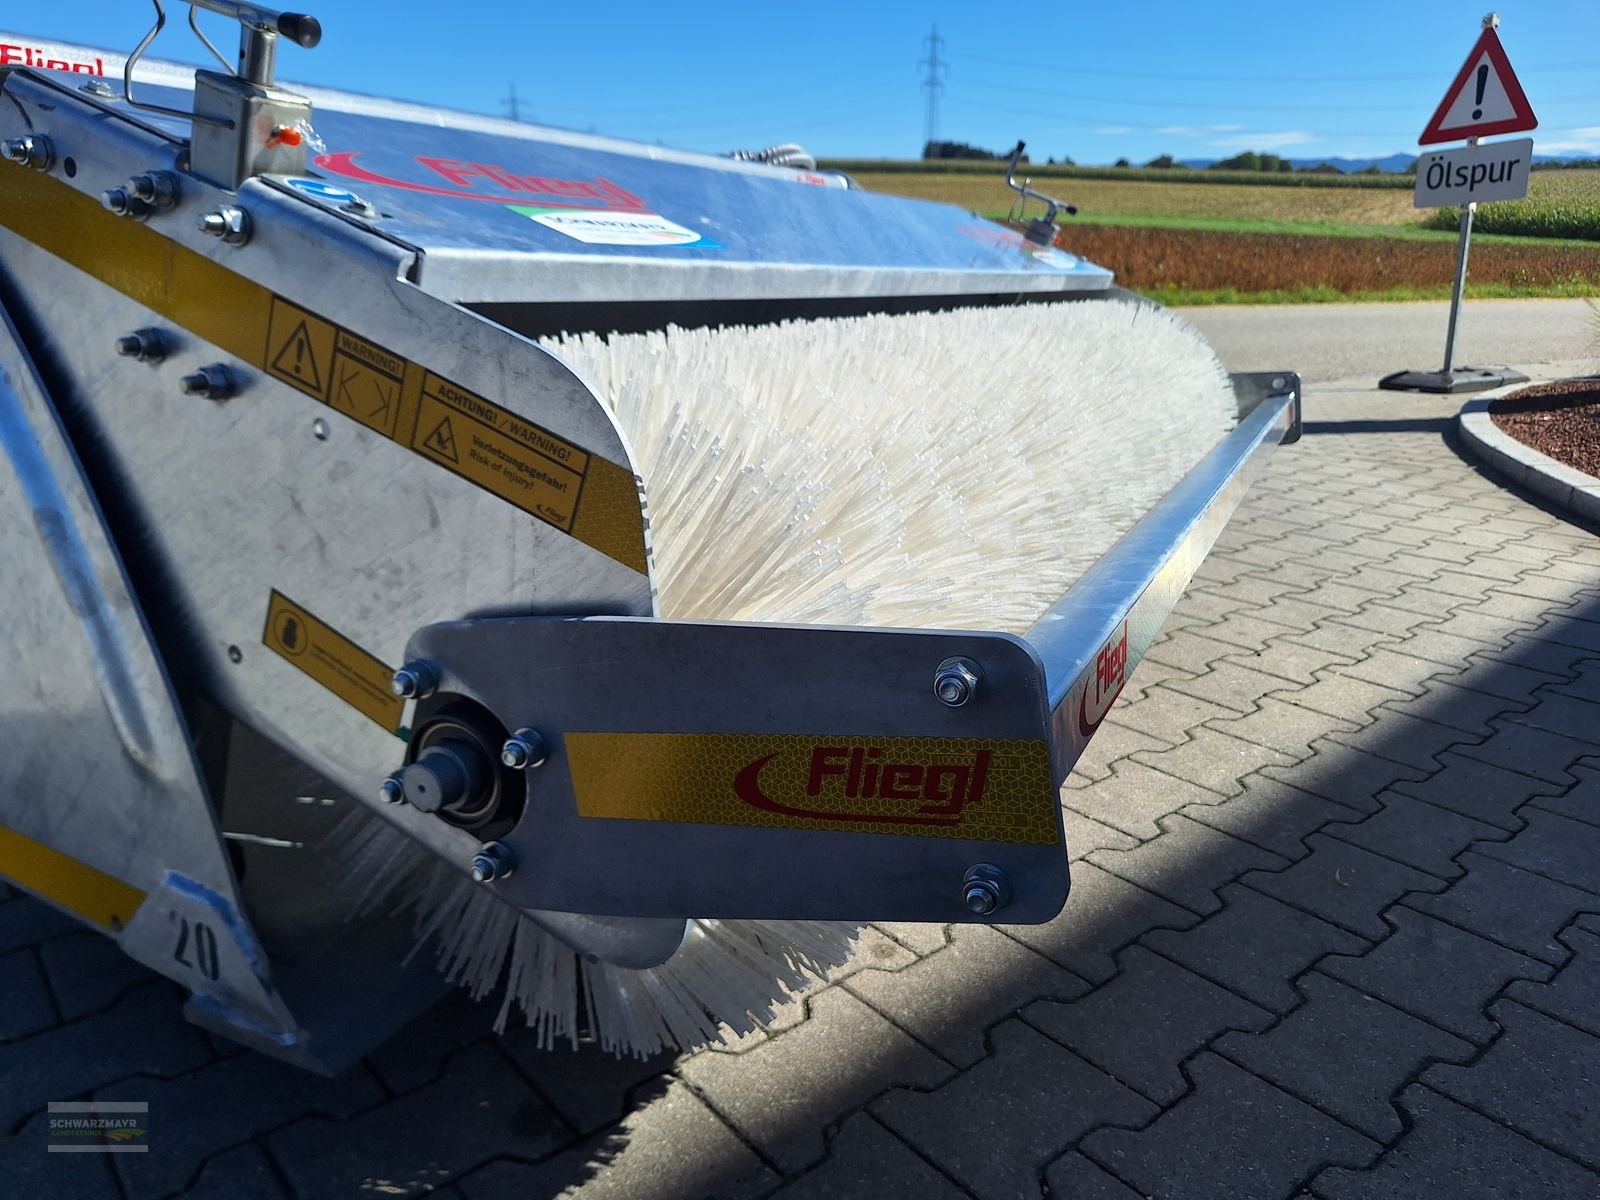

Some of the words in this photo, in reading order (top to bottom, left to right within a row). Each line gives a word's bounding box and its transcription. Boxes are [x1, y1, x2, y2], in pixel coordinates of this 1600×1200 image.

[1426, 155, 1521, 192] Ölspur
[341, 334, 400, 375] WARNING!
[438, 384, 498, 424] ACHTUNG!
[510, 421, 572, 463] WARNING!
[468, 448, 490, 466] Risk
[491, 461, 504, 473] of
[1096, 619, 1128, 706] Fliegl
[806, 746, 992, 814] Fliegl
